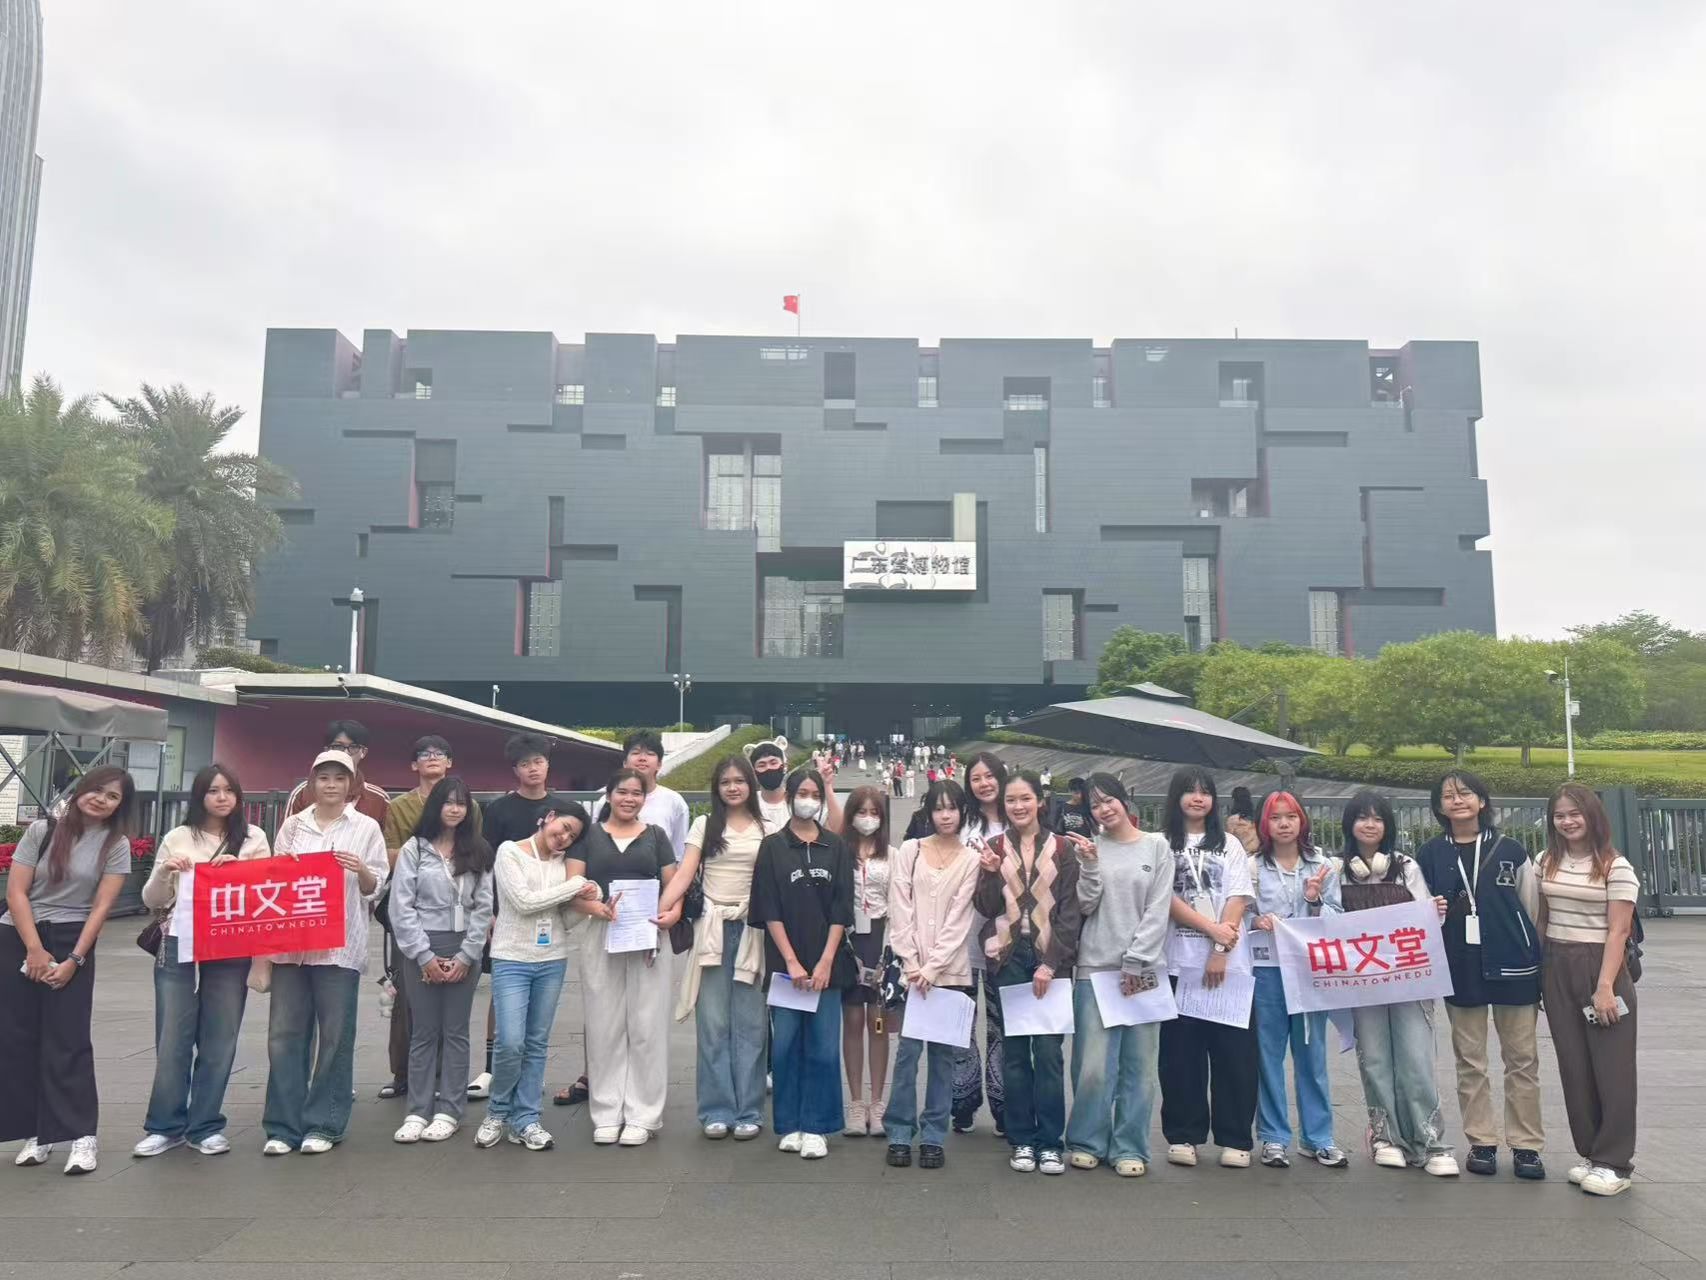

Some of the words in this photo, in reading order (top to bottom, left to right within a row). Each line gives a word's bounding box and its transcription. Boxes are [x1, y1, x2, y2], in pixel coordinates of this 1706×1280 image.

[1496, 860, 1516, 887] A
[210, 875, 327, 921] 中文堂
[210, 918, 327, 936] CHINATOWNEDU
[1307, 927, 1430, 975] 中文堂
[1312, 969, 1432, 988] CHINATOWNEDU
